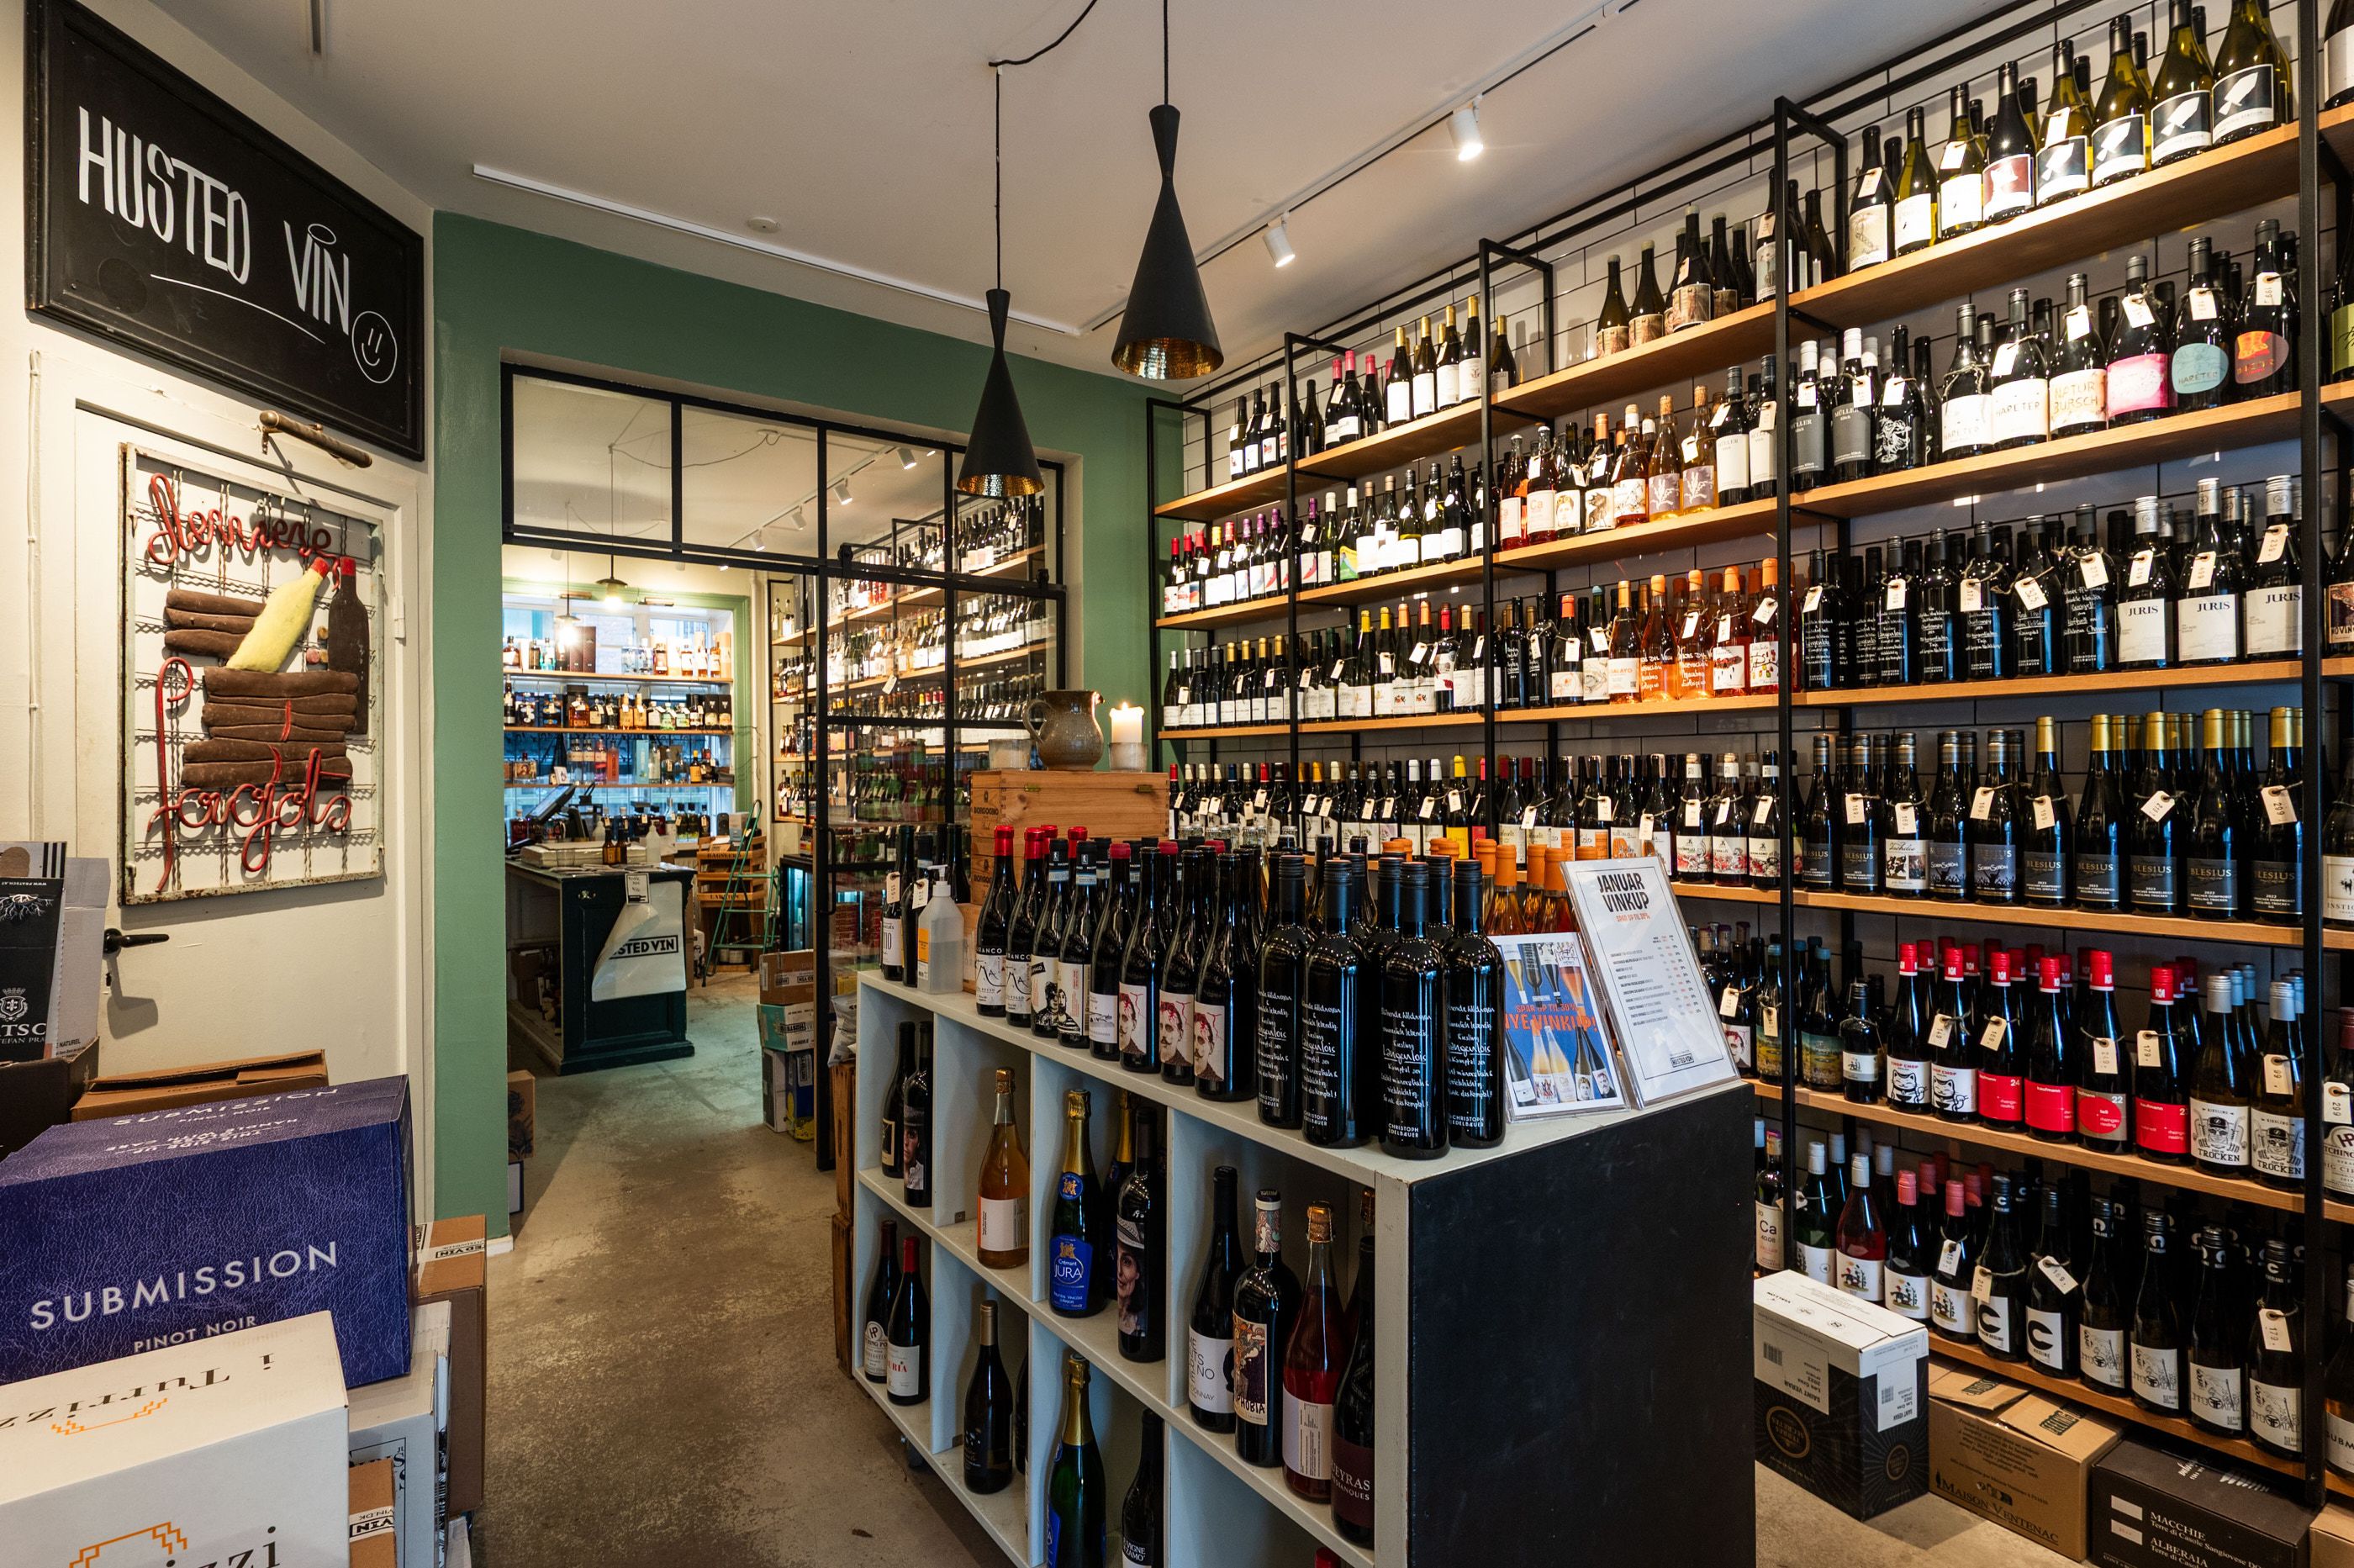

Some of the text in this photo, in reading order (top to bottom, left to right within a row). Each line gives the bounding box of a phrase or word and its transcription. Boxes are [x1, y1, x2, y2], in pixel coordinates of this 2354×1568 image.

[78, 106, 349, 335] HUSTED VIN
[2265, 591, 2302, 605] JURIS
[2129, 604, 2159, 617] JURIS
[2197, 600, 2230, 613] JURIS
[974, 806, 999, 816] BORGOGNO
[2133, 865, 2172, 874] BLESIUS
[2190, 868, 2232, 877] BLESIUS
[1597, 872, 1645, 893] JANUAR
[1602, 891, 1649, 913] VINKUP
[614, 938, 674, 956] STED VIN
[1516, 1004, 1532, 1013] SPAR
[2111, 1095, 2124, 1104] 22
[2331, 1101, 2341, 1117] 299
[1452, 1114, 1485, 1122] CHRISTOPH
[1388, 1122, 1419, 1133] CHRISTOPH
[2198, 1148, 2241, 1163] TROCKEN
[2256, 1159, 2302, 1175] TROCKEN
[1760, 1219, 1777, 1236] Ca
[1053, 1264, 1083, 1279] JURA
[30, 1240, 338, 1331] SUBMISSION
[133, 1315, 258, 1355] PINOT NOIR
[1942, 1477, 1989, 1510] MAISON
[1992, 1501, 2060, 1543] VENTENAC
[2150, 1511, 2206, 1542] MACCHIE
[2151, 1520, 2170, 1534] Terre
[2178, 1531, 2204, 1548] Casole
[2204, 1542, 2247, 1566] Sangiovese
[2150, 1536, 2209, 1568] ALBERAIA
